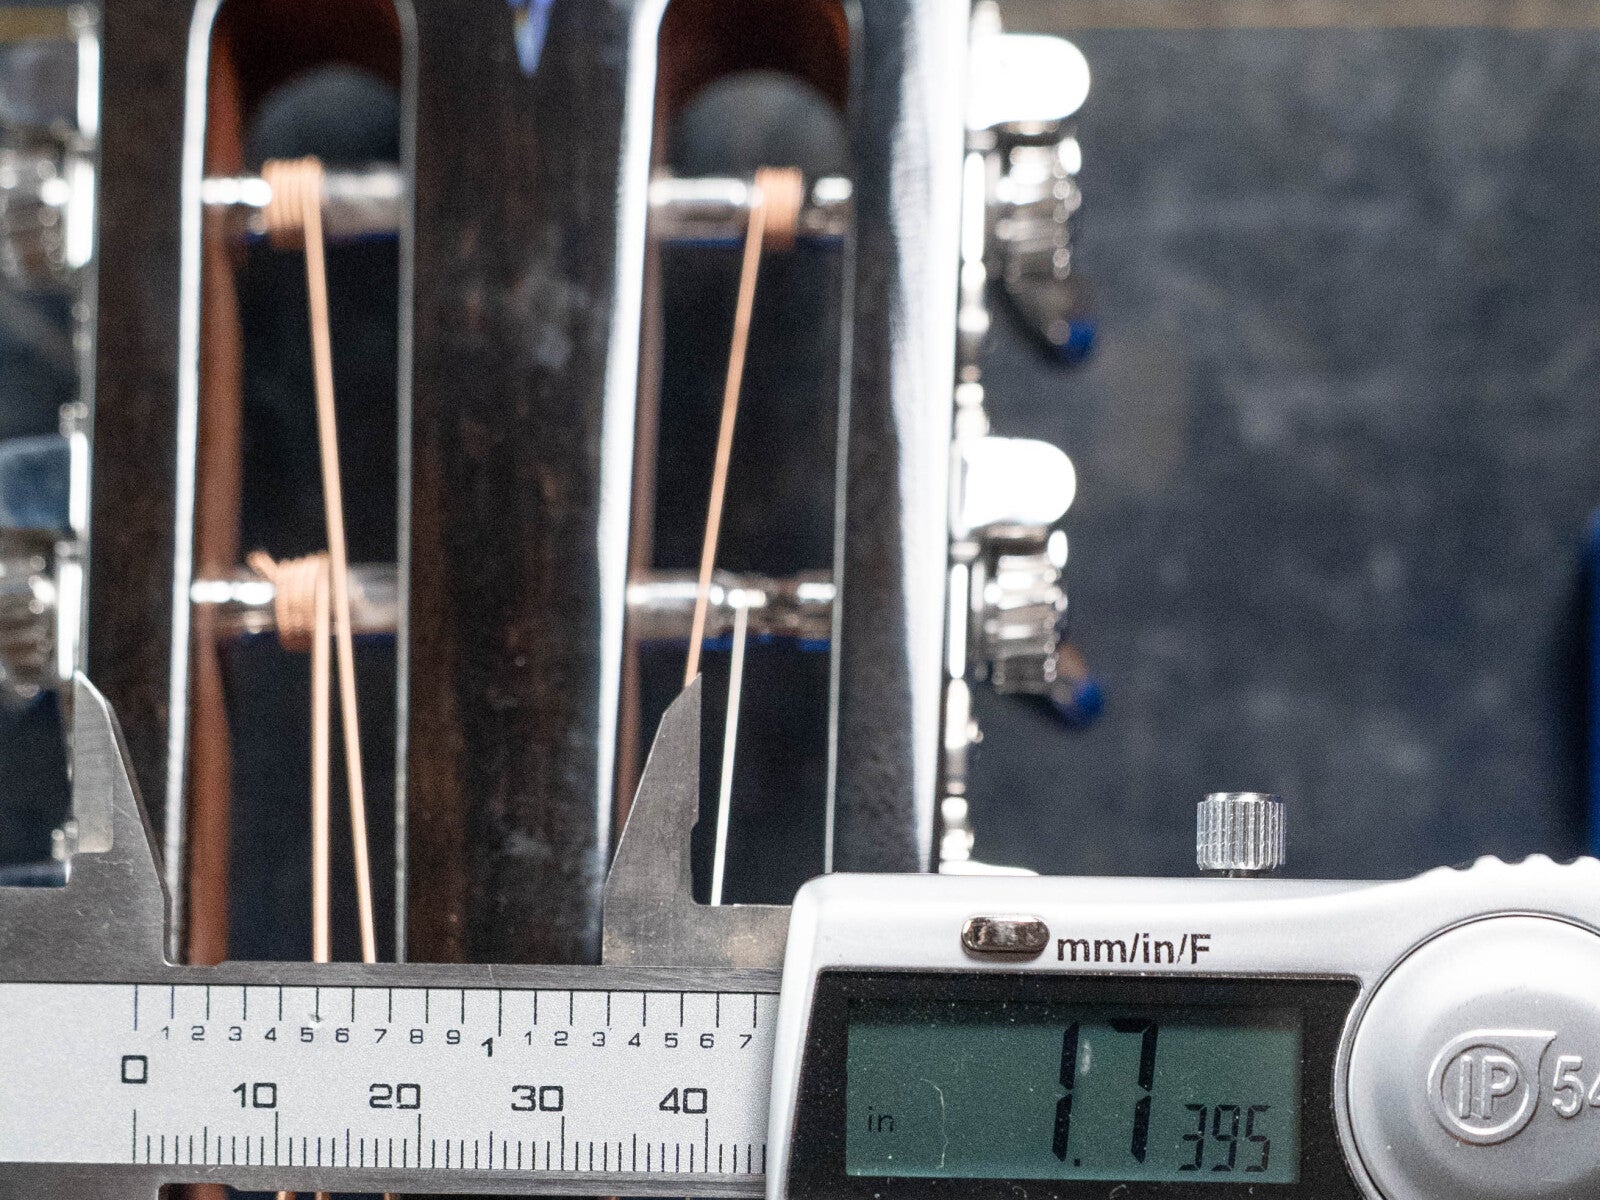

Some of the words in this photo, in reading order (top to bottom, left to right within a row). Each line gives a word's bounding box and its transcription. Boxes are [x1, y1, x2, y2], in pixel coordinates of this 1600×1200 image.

[1057, 933, 1211, 965] mm/in/F
[161, 1025, 170, 1040] 1
[191, 1025, 205, 1041] 2
[228, 1026, 242, 1042] 3
[264, 1027, 278, 1042] 4
[300, 1027, 314, 1043] 5
[335, 1028, 350, 1043] 6
[374, 1028, 387, 1044] 7
[409, 1029, 424, 1045] 8
[446, 1029, 461, 1045] 9
[481, 1037, 494, 1057] 1
[524, 1031, 532, 1045] 1
[553, 1031, 569, 1046] 2
[591, 1031, 606, 1047] 3
[628, 1032, 641, 1048] 4
[664, 1032, 678, 1048] 5
[700, 1033, 714, 1049] 6
[739, 1034, 753, 1049] 7
[121, 1055, 148, 1084] 0
[232, 1082, 277, 1108] 10
[369, 1083, 421, 1109] 20
[511, 1085, 564, 1111] 30
[658, 1088, 708, 1114] 40
[1458, 1055, 1519, 1119] IP
[867, 1107, 894, 1133] in
